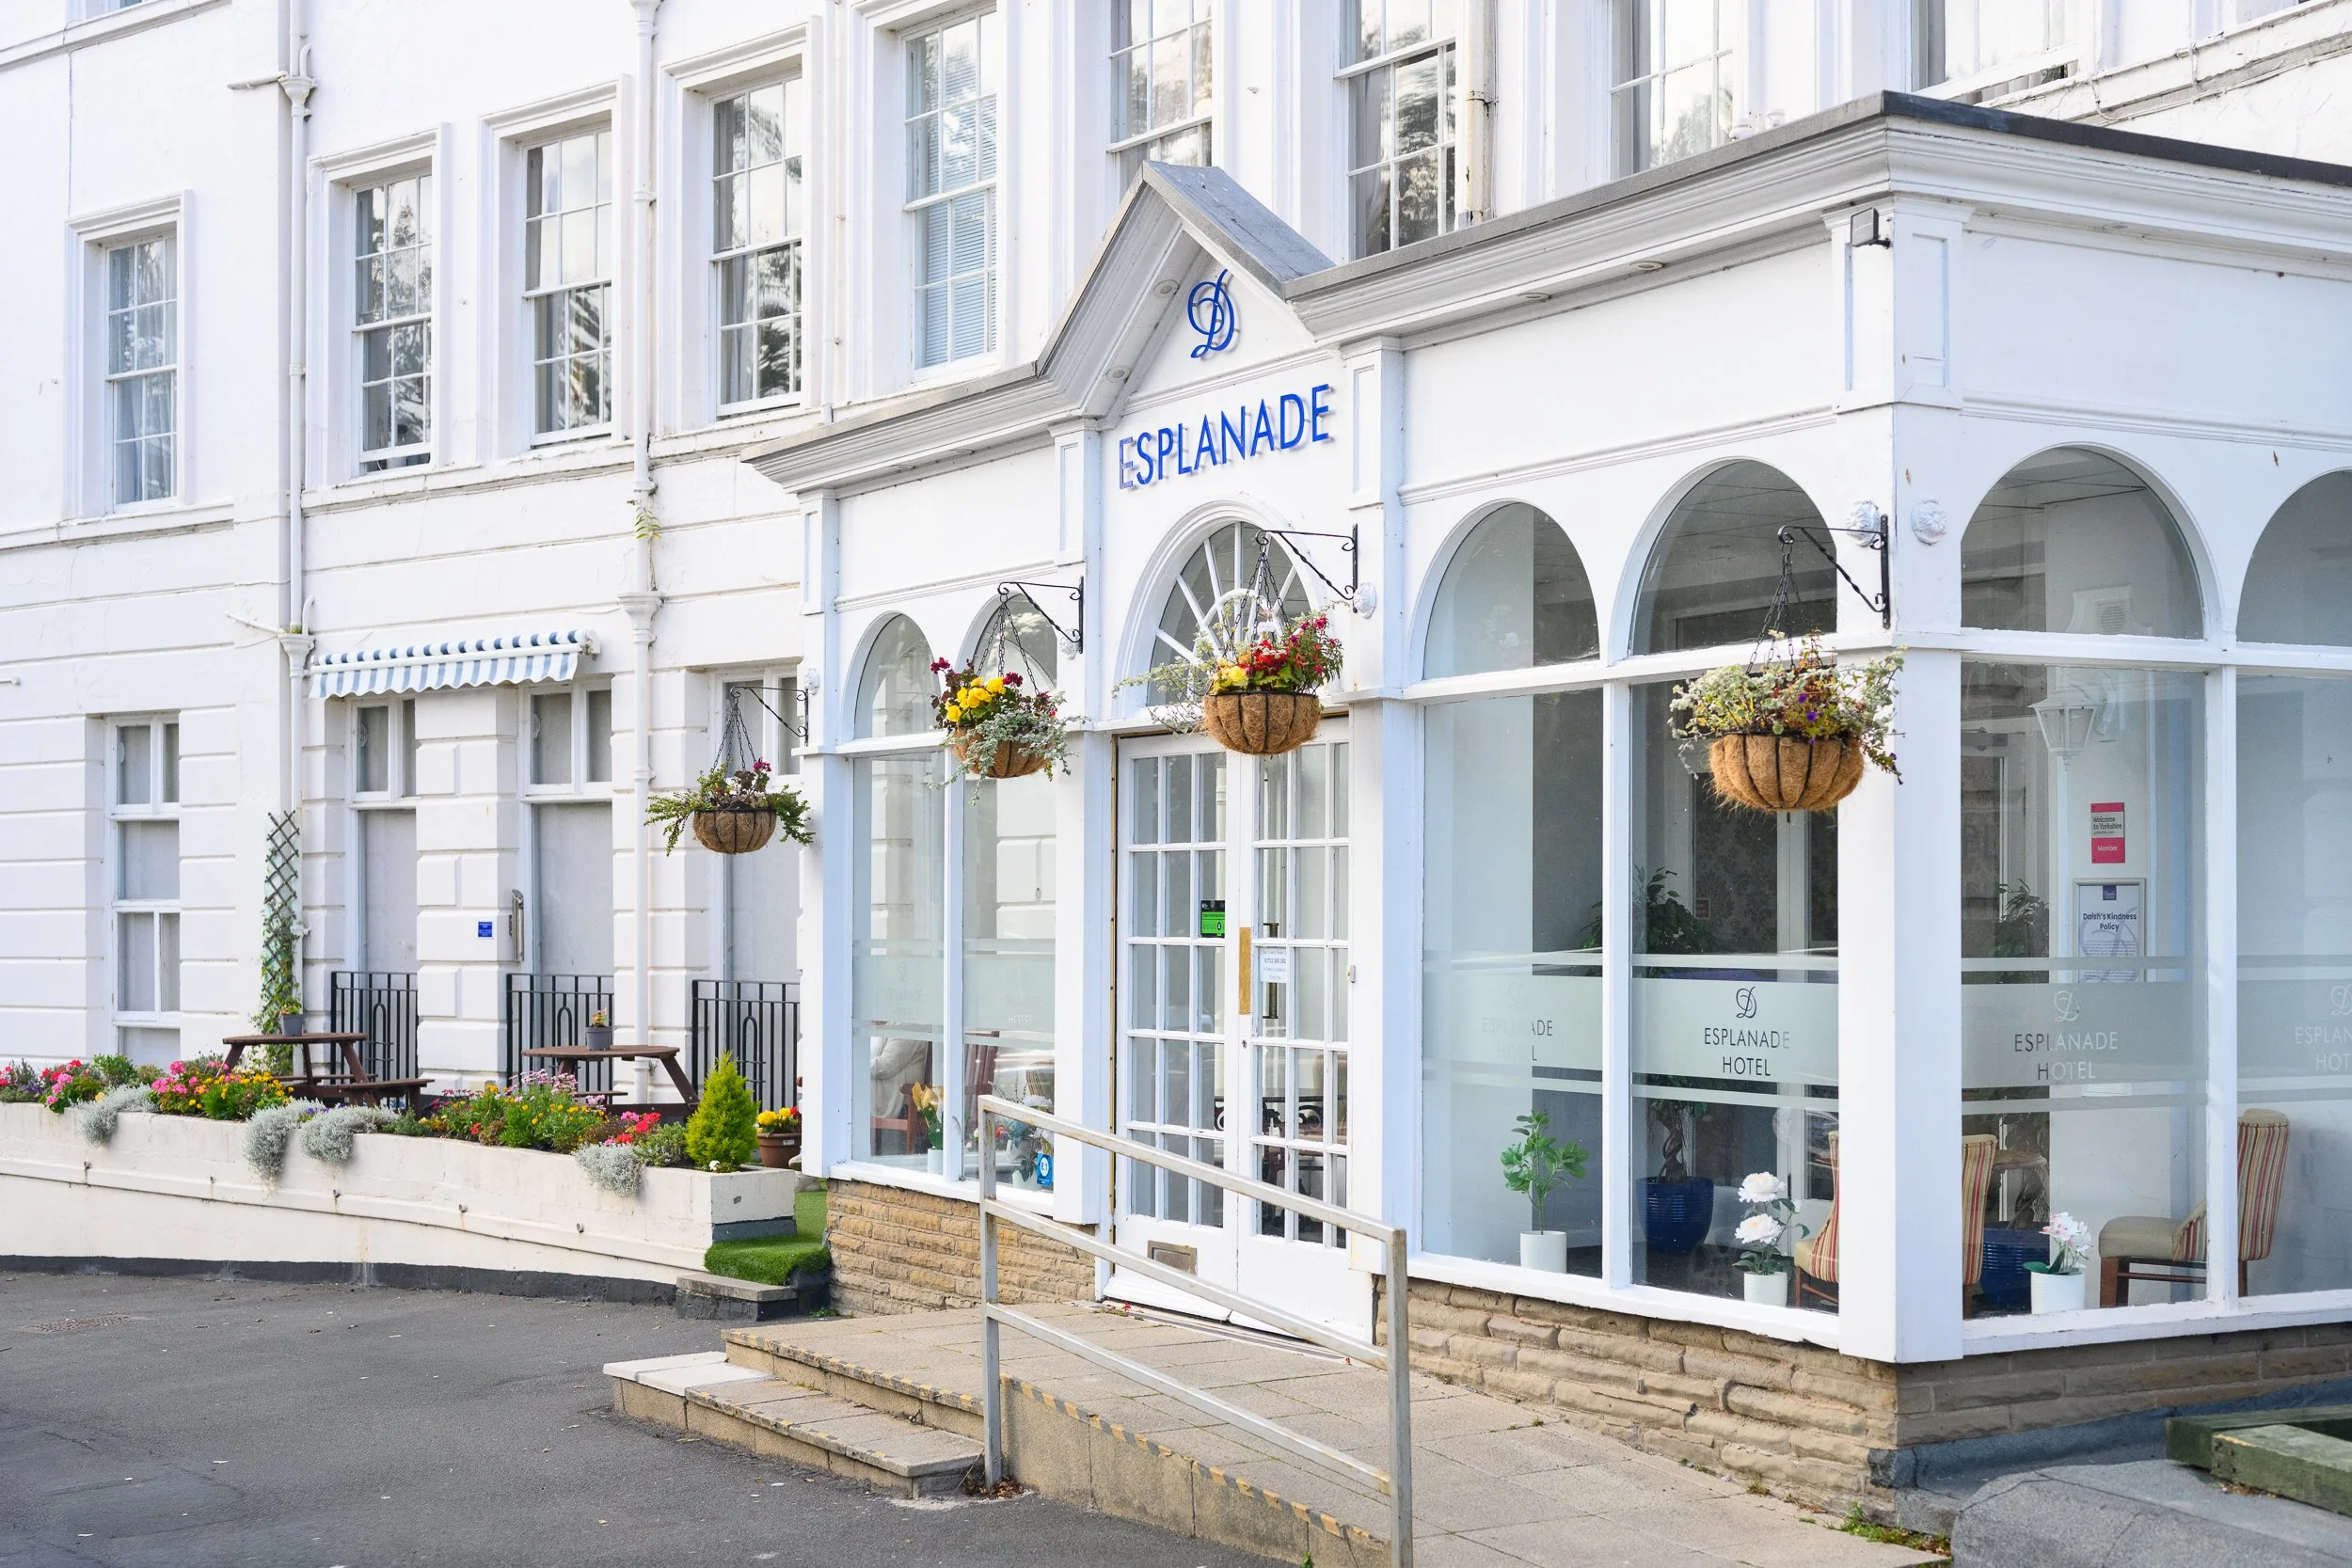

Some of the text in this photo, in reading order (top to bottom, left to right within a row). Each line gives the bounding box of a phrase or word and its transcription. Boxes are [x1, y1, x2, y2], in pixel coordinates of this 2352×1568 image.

[1119, 383, 1329, 490] ESPLANADE
[2099, 923, 2120, 933] Policy
[1704, 1027, 1789, 1049] ESPLANADE
[2014, 1031, 2118, 1053] ESPLANADE
[1723, 1056, 1771, 1076] HOTEL
[2038, 1061, 2095, 1081] HOTEL
